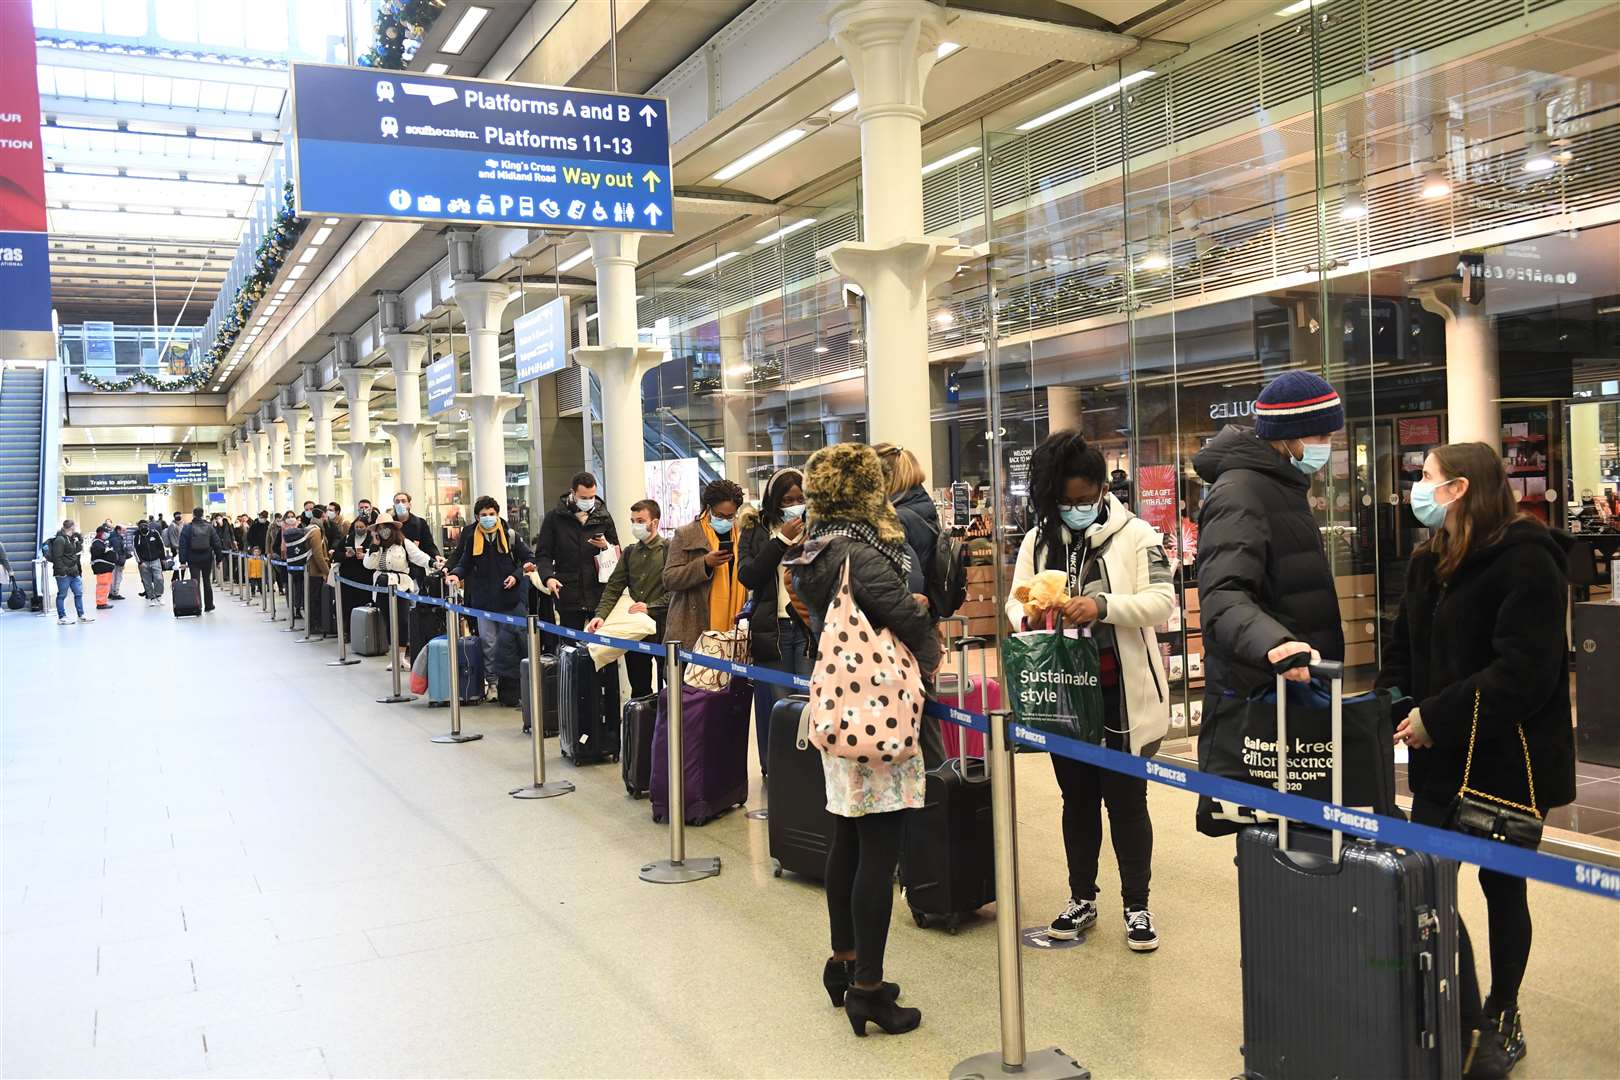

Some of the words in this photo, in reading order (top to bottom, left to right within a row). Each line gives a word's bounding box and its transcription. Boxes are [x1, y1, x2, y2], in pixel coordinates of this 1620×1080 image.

[464, 90, 559, 116] Platforms
[562, 100, 576, 117] A
[580, 104, 613, 120] and
[618, 105, 631, 122] B
[484, 126, 579, 151] Platforms
[582, 135, 633, 155] 11-13
[501, 160, 529, 172] King's
[530, 161, 556, 173] Cross
[478, 170, 496, 179] and
[497, 171, 532, 182] Midland
[534, 172, 556, 184] Road
[562, 166, 600, 190] Way
[605, 172, 634, 188] out
[117, 479, 137, 487] airports
[1020, 669, 1098, 686] Sustainable
[1020, 687, 1057, 705] style
[1154, 763, 1186, 783] Pancras
[1248, 769, 1278, 779] VIRGIL
[1333, 807, 1379, 832] Pancras
